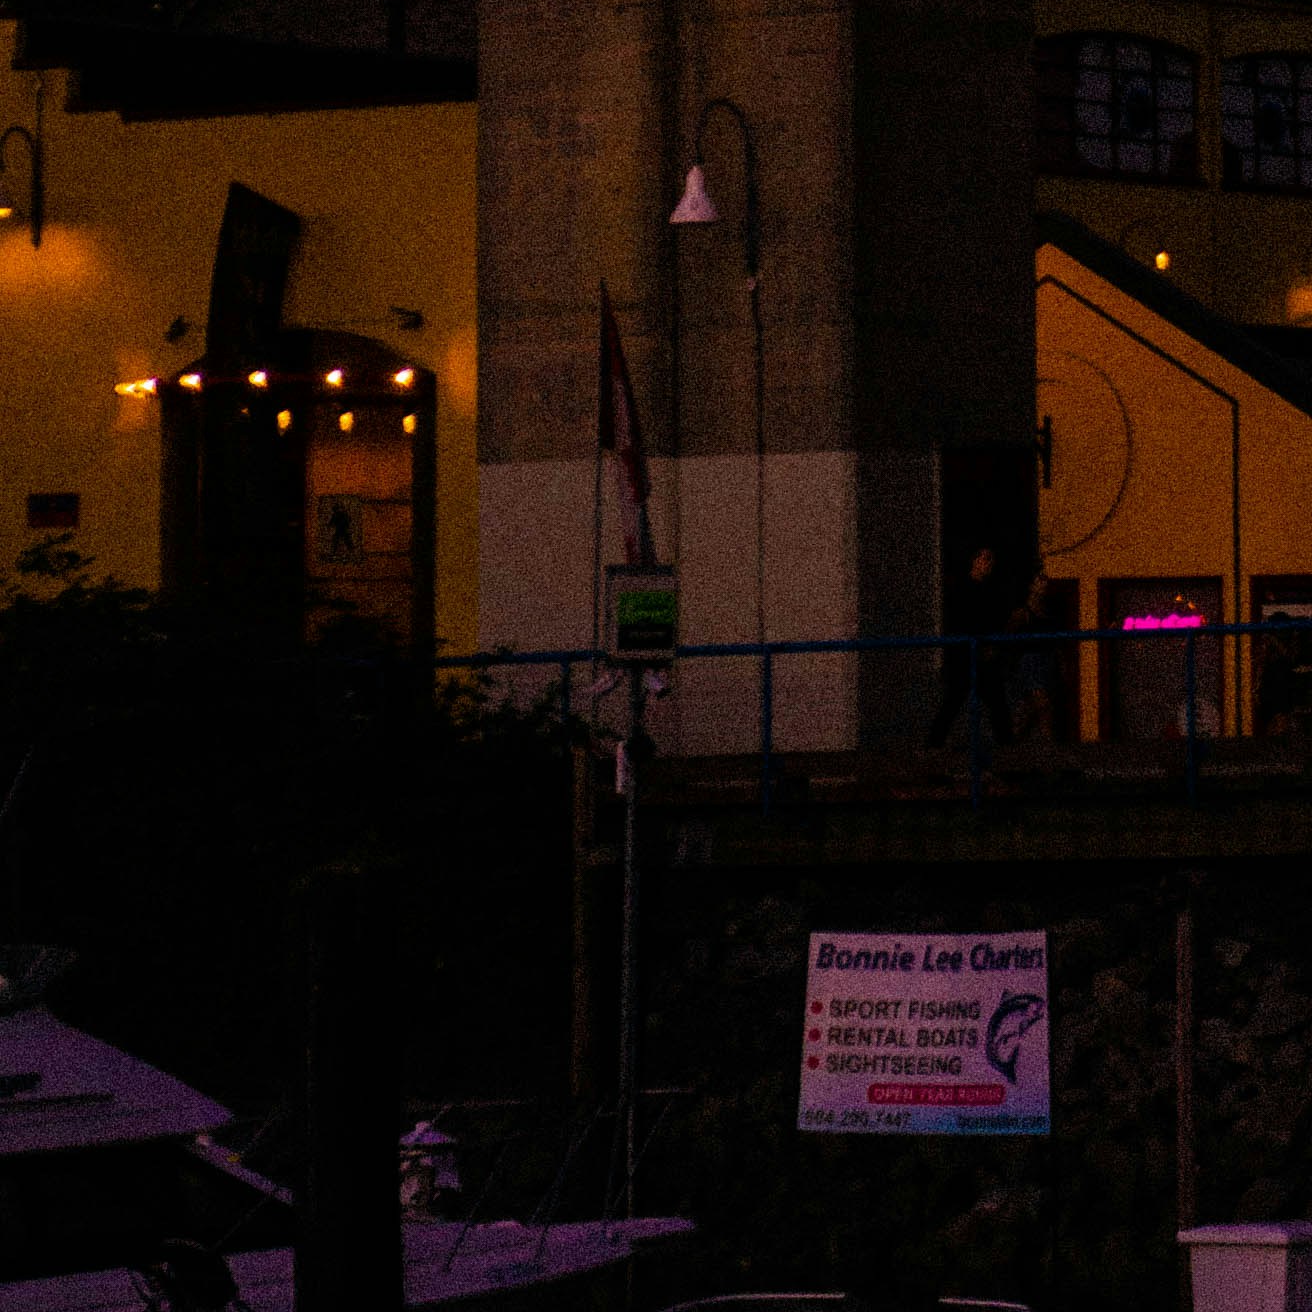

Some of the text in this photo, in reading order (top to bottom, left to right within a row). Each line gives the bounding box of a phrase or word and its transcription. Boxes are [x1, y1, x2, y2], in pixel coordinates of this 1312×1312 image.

[816, 942, 1043, 972] Bonnie Lee Charters
[829, 999, 981, 1021] SPORT FISHING
[827, 1027, 979, 1048] RENTAL BOATS
[826, 1055, 963, 1076] SIGHTSEEING
